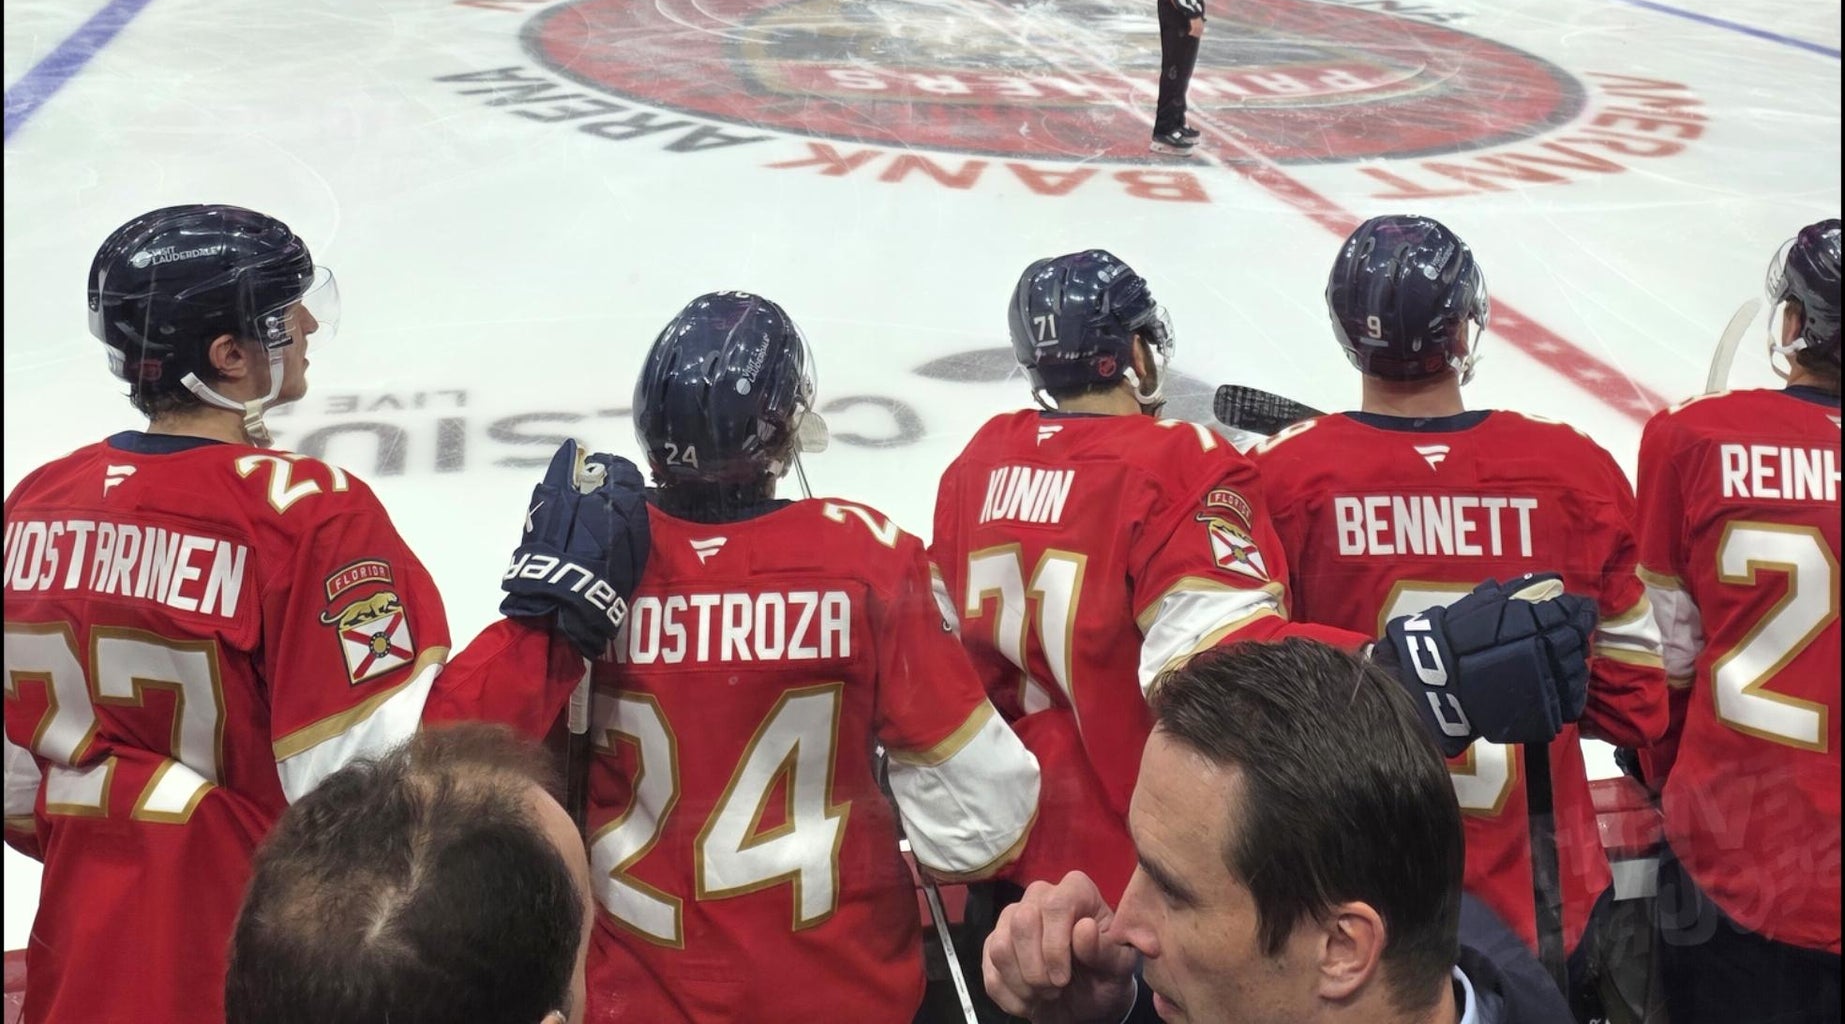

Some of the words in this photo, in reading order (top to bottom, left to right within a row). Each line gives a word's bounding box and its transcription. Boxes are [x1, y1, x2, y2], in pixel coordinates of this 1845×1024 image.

[825, 66, 1377, 97] PANHERS
[432, 64, 777, 153] ARENA
[760, 141, 1213, 204] BANK
[152, 246, 218, 266] LAUDERDALE
[1033, 314, 1057, 341] 71
[1366, 315, 1382, 339] 9
[325, 388, 468, 415] LIVE
[664, 441, 699, 469] 24
[979, 466, 1076, 525] KUNIN
[1334, 495, 1539, 557] BENNETT
[334, 564, 386, 591] FLORIDA
[965, 542, 1088, 726] 71
[4, 622, 227, 825] 27
[590, 682, 852, 950] 24
